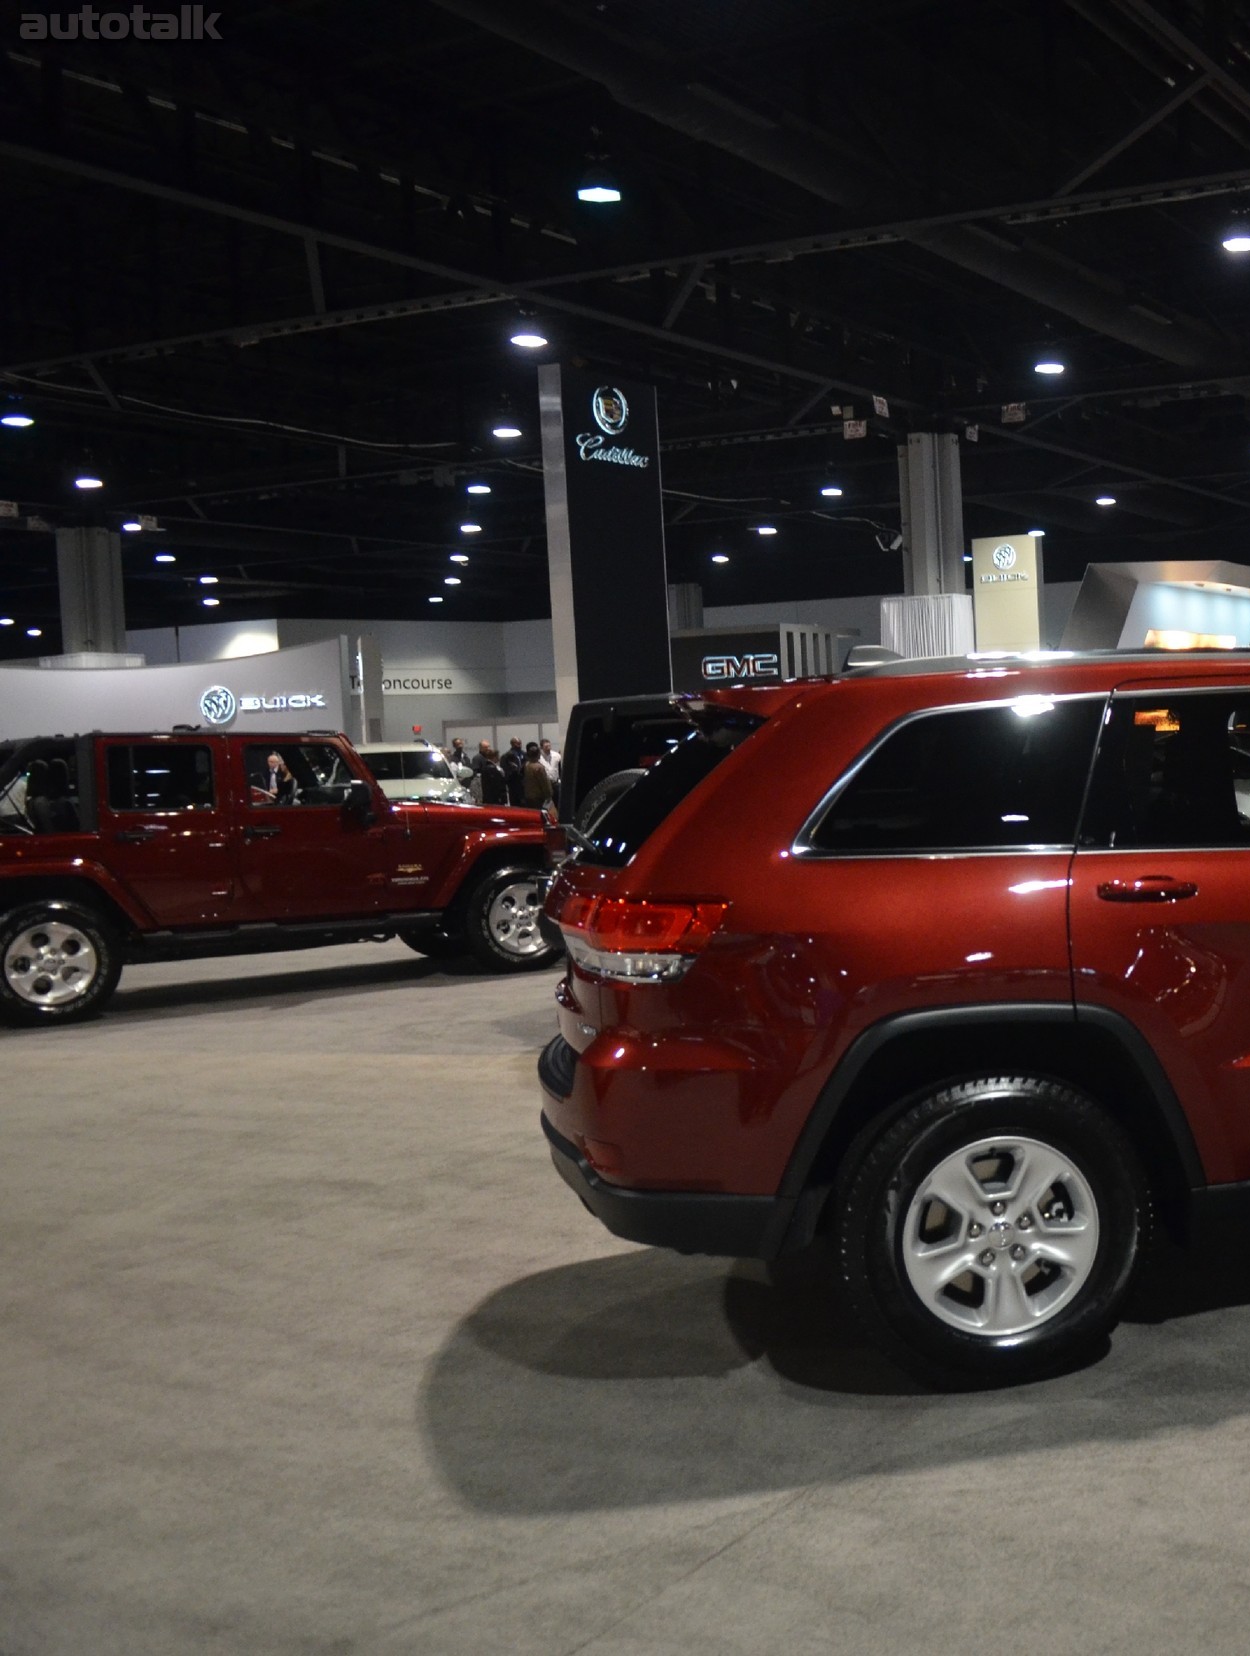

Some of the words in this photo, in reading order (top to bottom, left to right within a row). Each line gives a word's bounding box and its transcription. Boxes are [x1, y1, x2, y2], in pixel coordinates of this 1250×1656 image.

[575, 432, 649, 468] Cadillac
[701, 653, 779, 680] GMC
[381, 678, 453, 690] oncourse
[239, 694, 326, 710] BUICK
